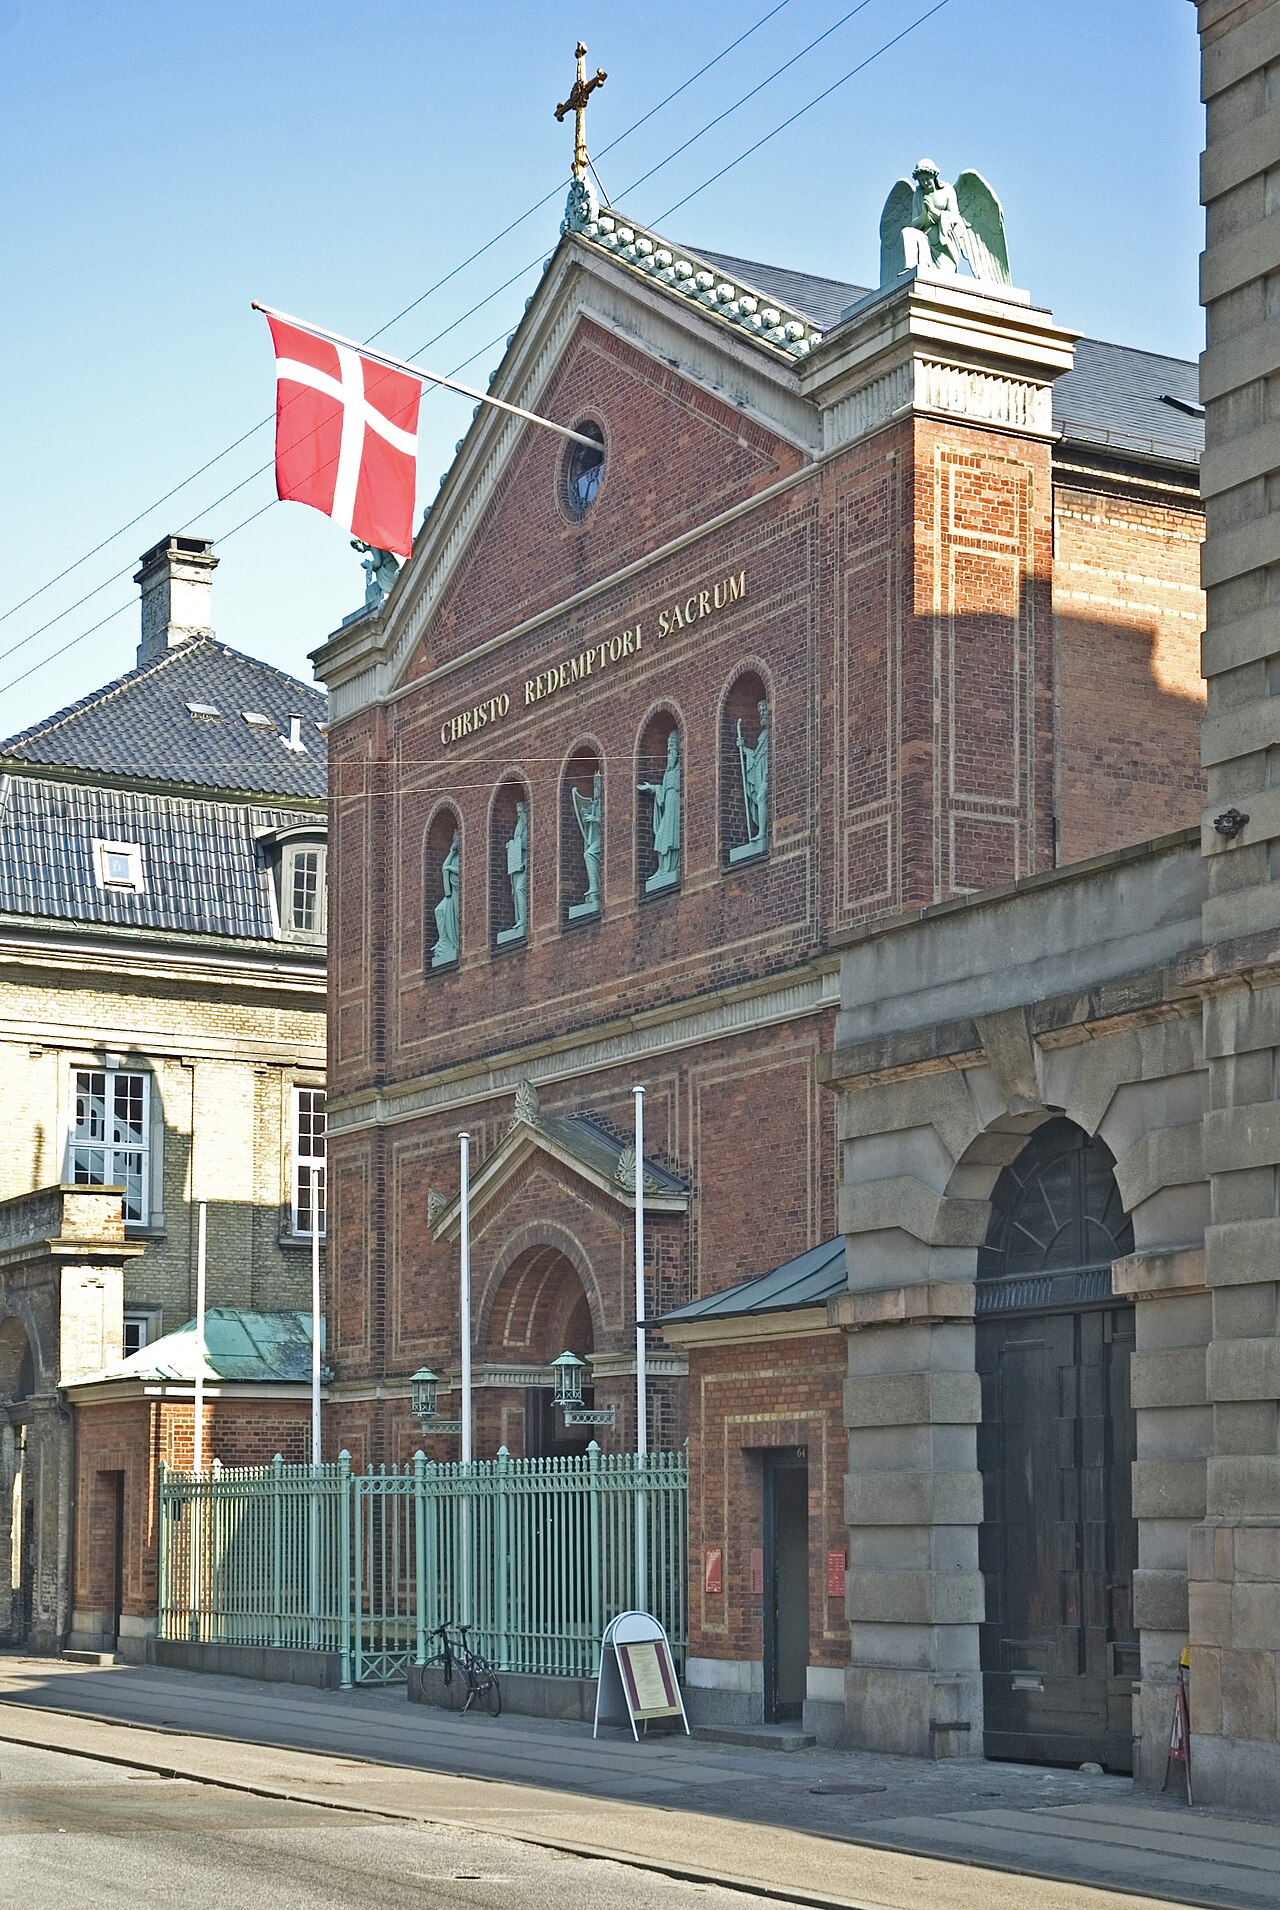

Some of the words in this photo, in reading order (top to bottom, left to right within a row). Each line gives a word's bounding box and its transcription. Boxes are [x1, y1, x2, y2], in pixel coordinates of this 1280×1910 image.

[440, 692, 510, 745] CHRISTO
[523, 624, 644, 706] REDEMPTORI
[657, 570, 748, 639] SACRUM
